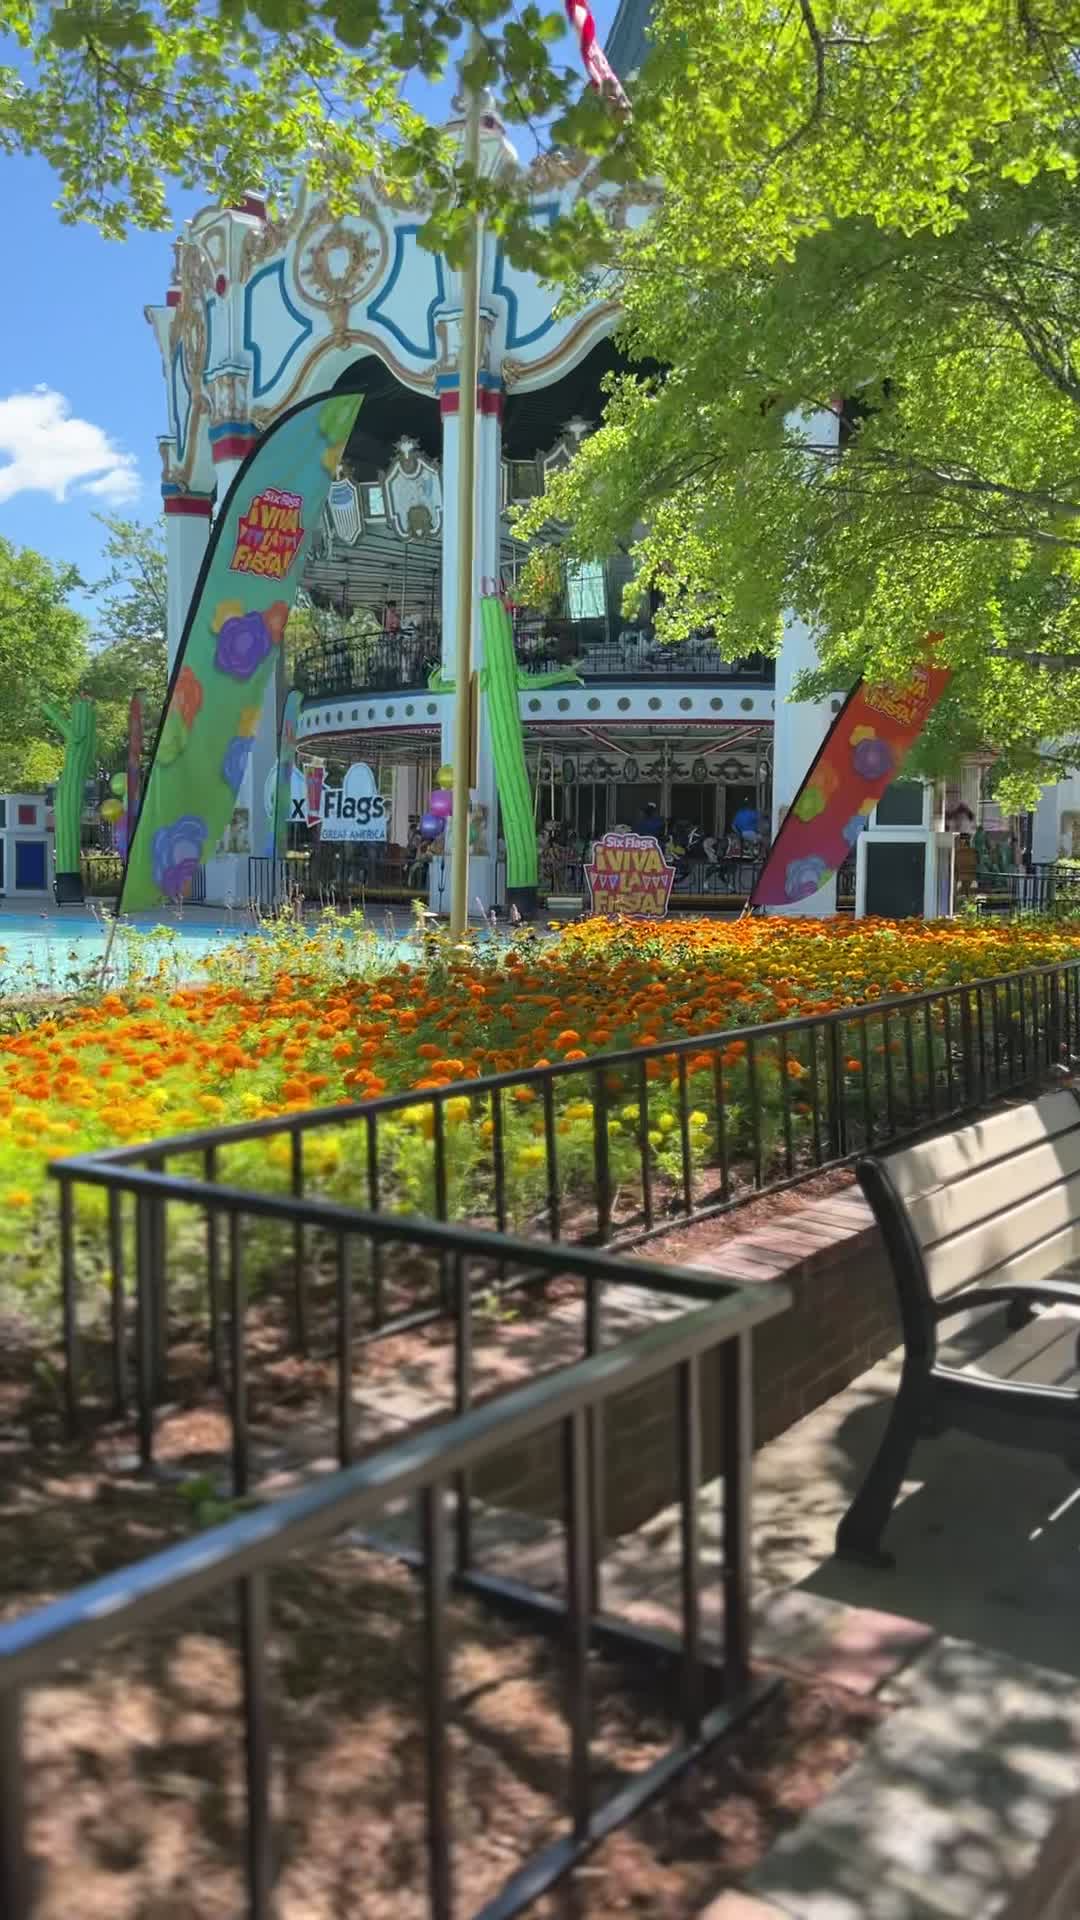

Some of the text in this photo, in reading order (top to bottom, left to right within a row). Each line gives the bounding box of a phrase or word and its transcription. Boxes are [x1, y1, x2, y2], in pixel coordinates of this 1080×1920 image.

[264, 491, 281, 505] Six
[324, 791, 384, 825] Flags
[350, 829, 385, 839] AMERICA
[606, 836, 655, 851] Six Flags
[619, 872, 642, 892] LA
